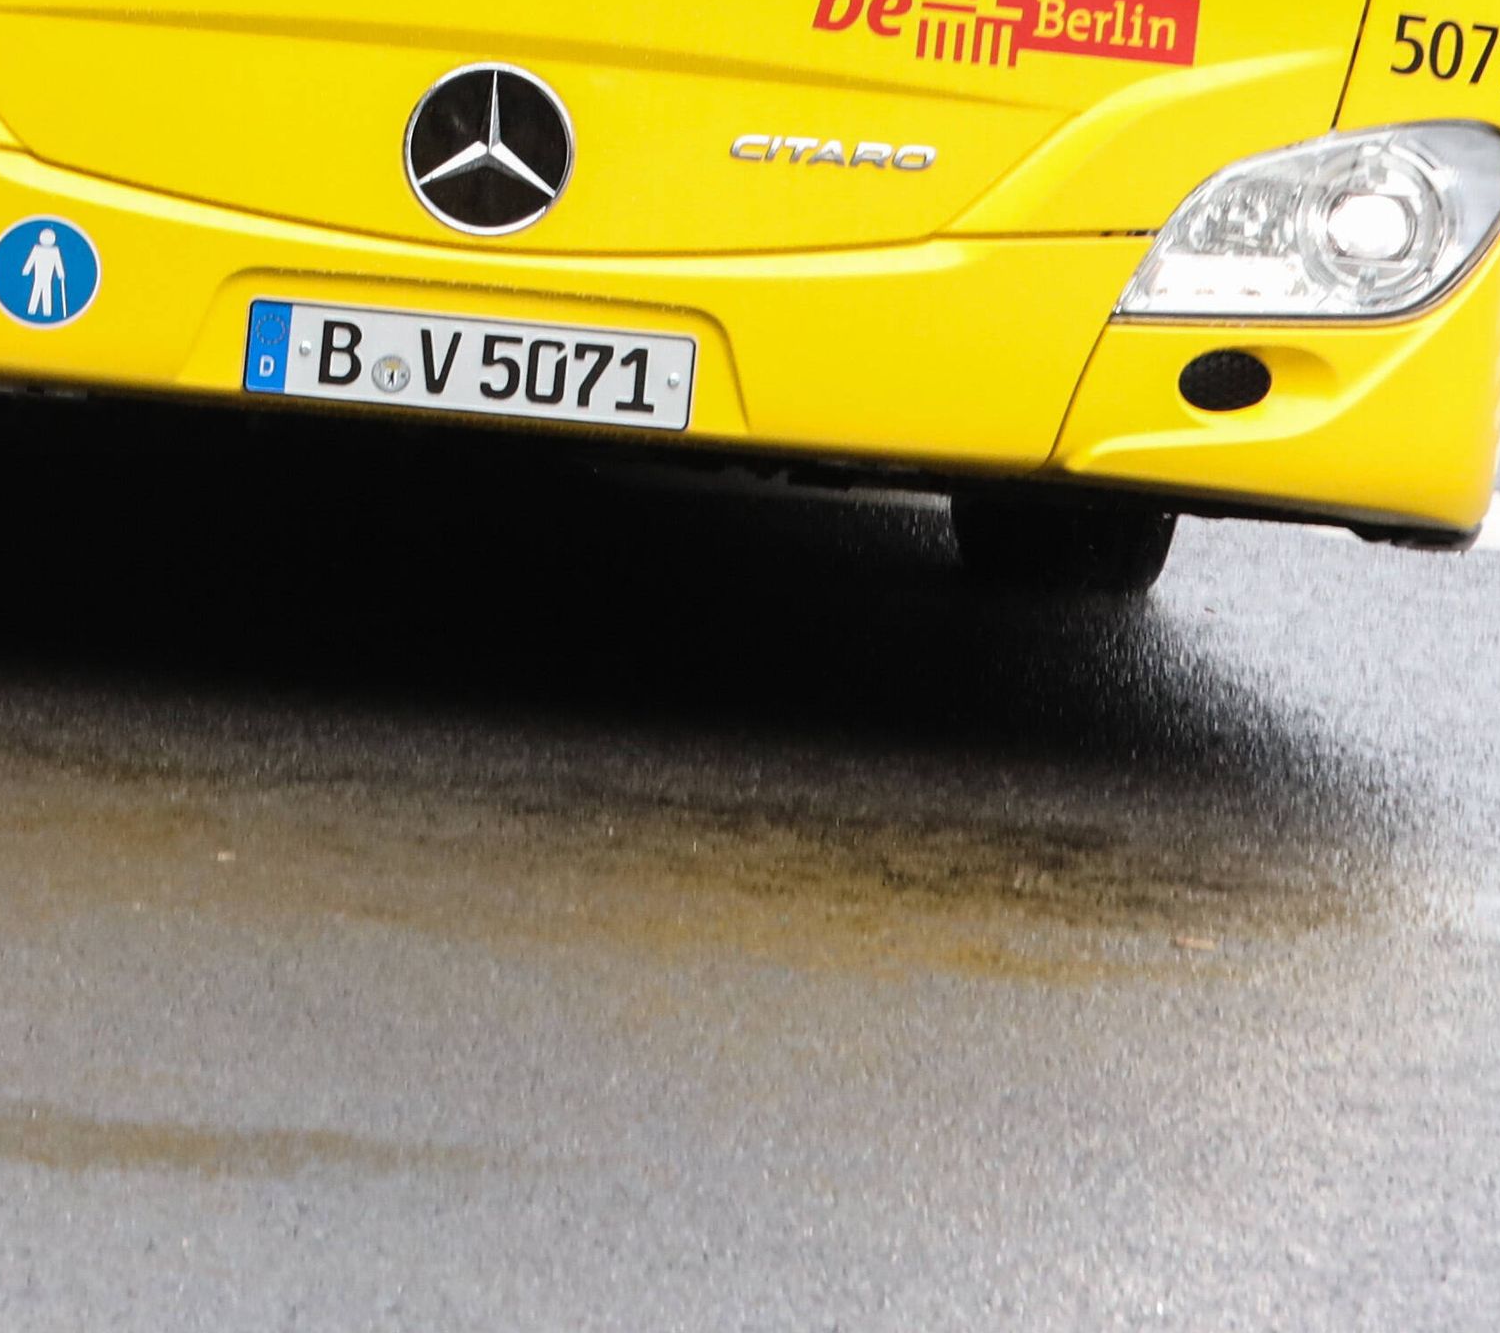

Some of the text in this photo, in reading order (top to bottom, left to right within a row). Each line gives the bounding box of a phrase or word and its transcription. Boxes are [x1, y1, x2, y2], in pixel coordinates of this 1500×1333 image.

[730, 133, 937, 171] CITARO
[258, 354, 275, 378] D
[317, 319, 655, 414] B V 5071
